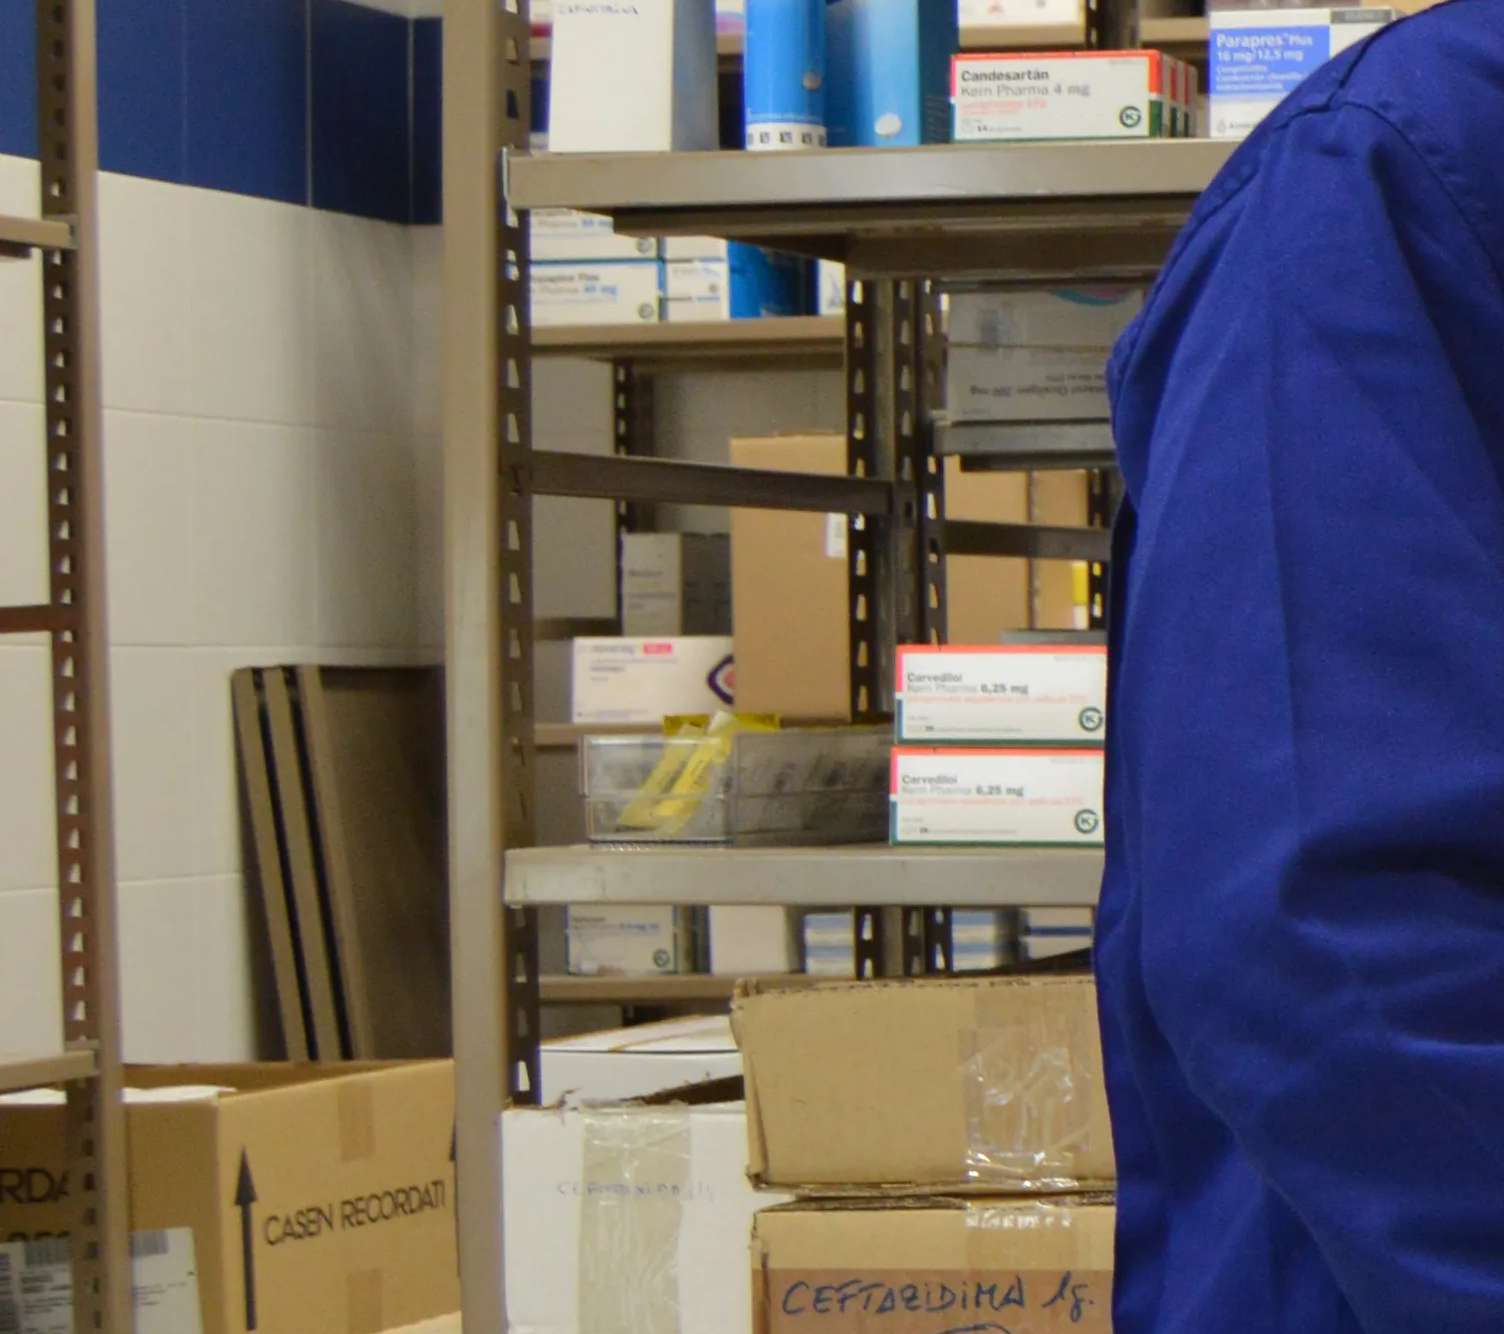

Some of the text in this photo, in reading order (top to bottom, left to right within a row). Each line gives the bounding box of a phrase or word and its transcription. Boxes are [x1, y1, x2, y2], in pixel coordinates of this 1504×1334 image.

[961, 67, 1050, 83] Candesartán
[961, 83, 1091, 100] Kern Pharma 4 mg
[906, 671, 963, 685] Carvedilol
[340, 1178, 446, 1232] RECORDATI
